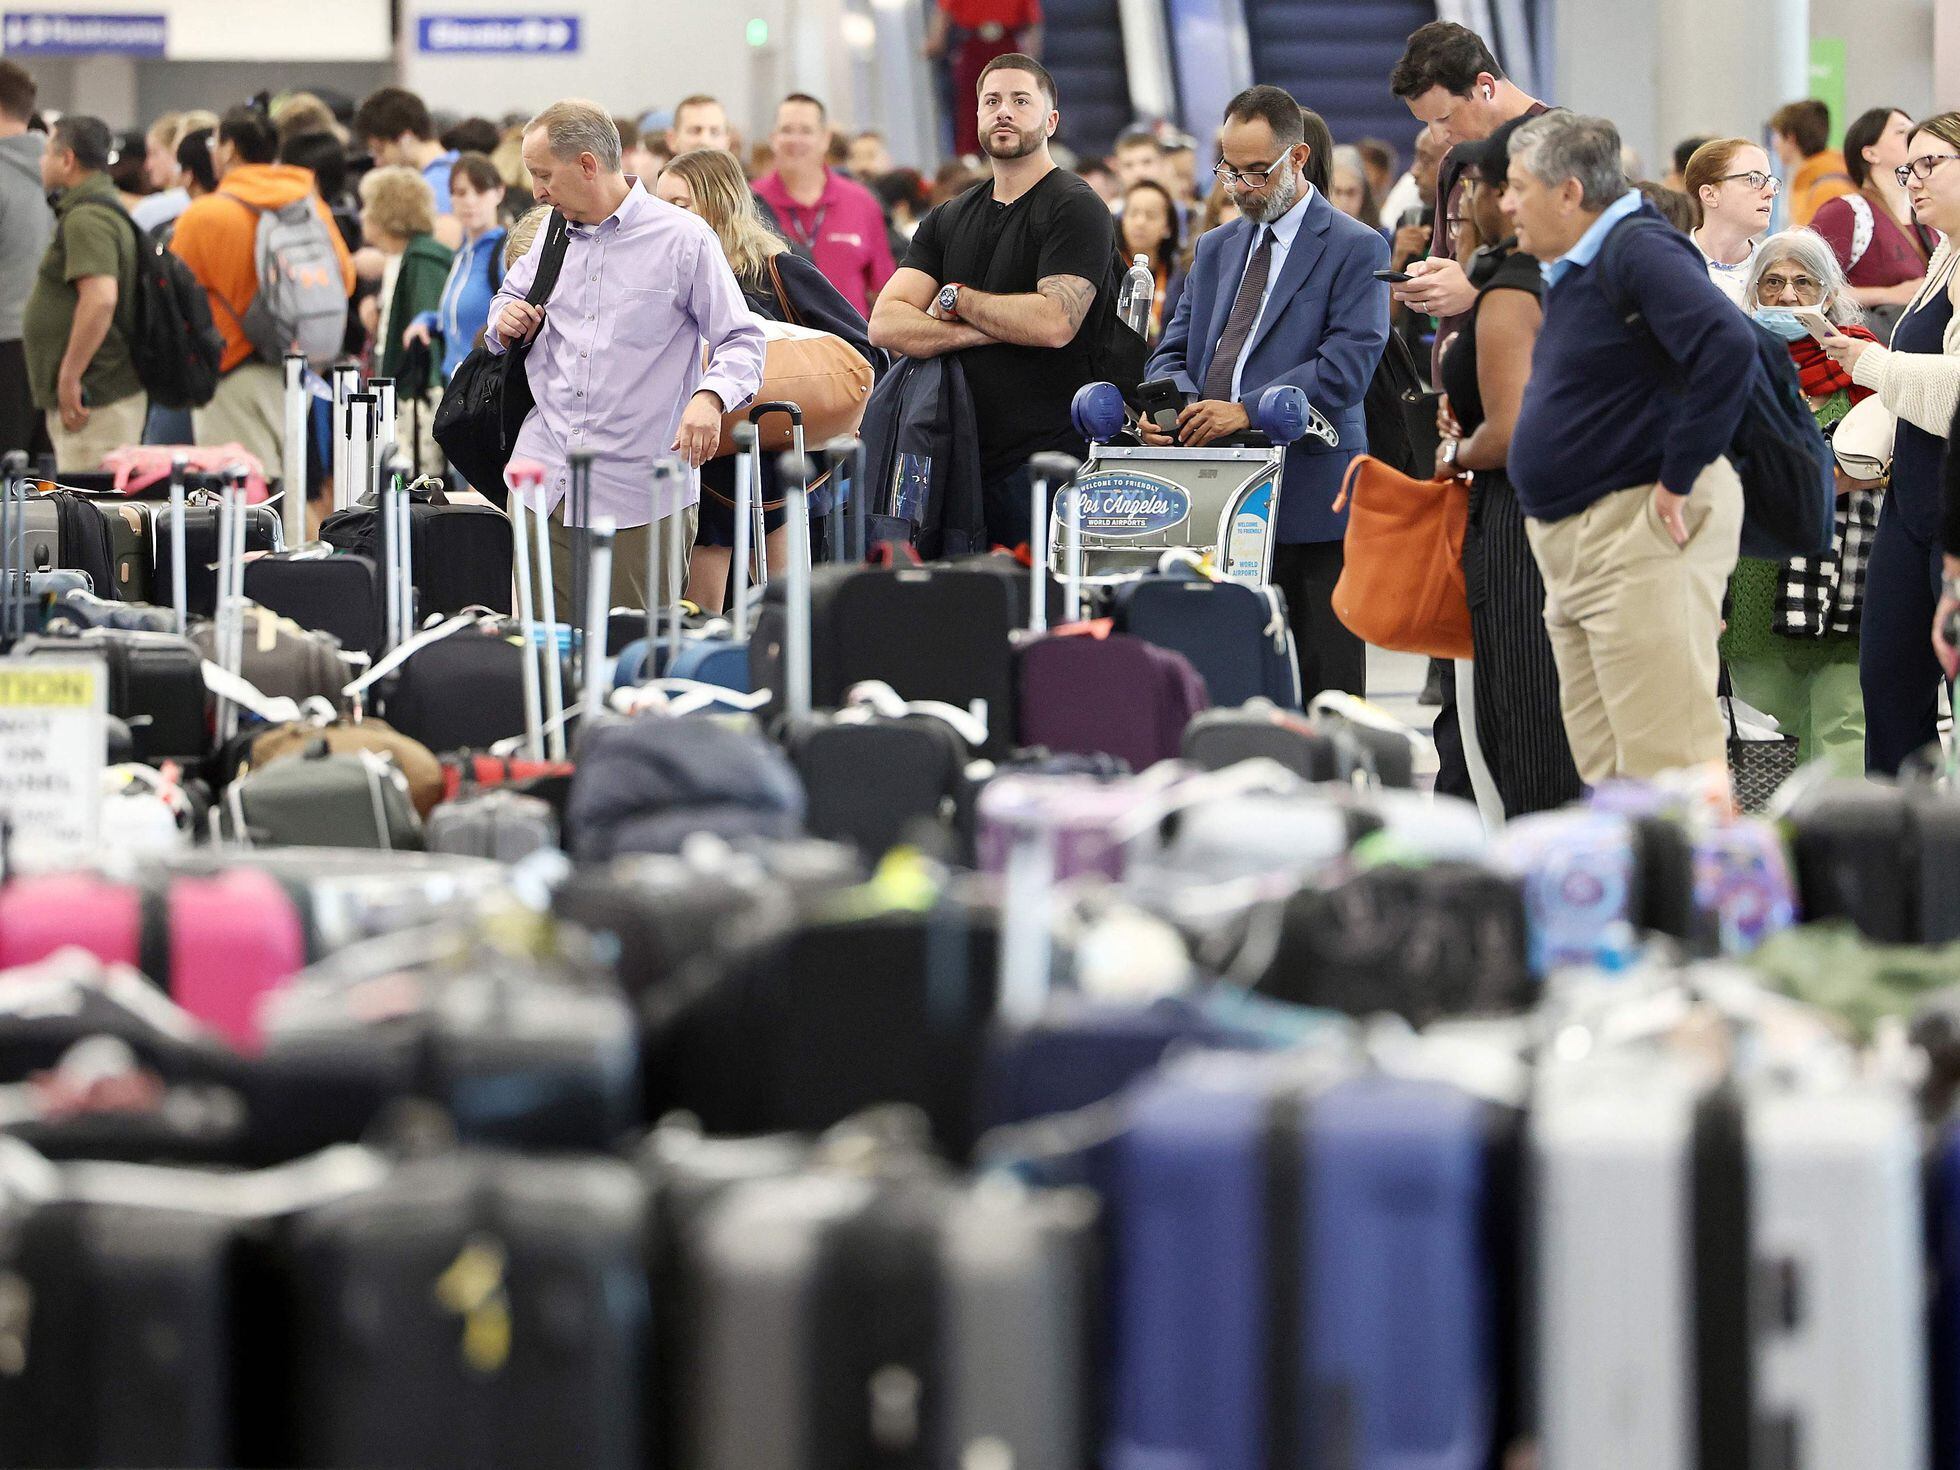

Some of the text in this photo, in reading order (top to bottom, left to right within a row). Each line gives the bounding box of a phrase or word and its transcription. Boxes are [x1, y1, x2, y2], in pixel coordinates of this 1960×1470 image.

[1080, 480, 1111, 493] WELCOME
[1125, 480, 1160, 493] FRIENDLY
[1076, 493, 1169, 519] Los Angeles
